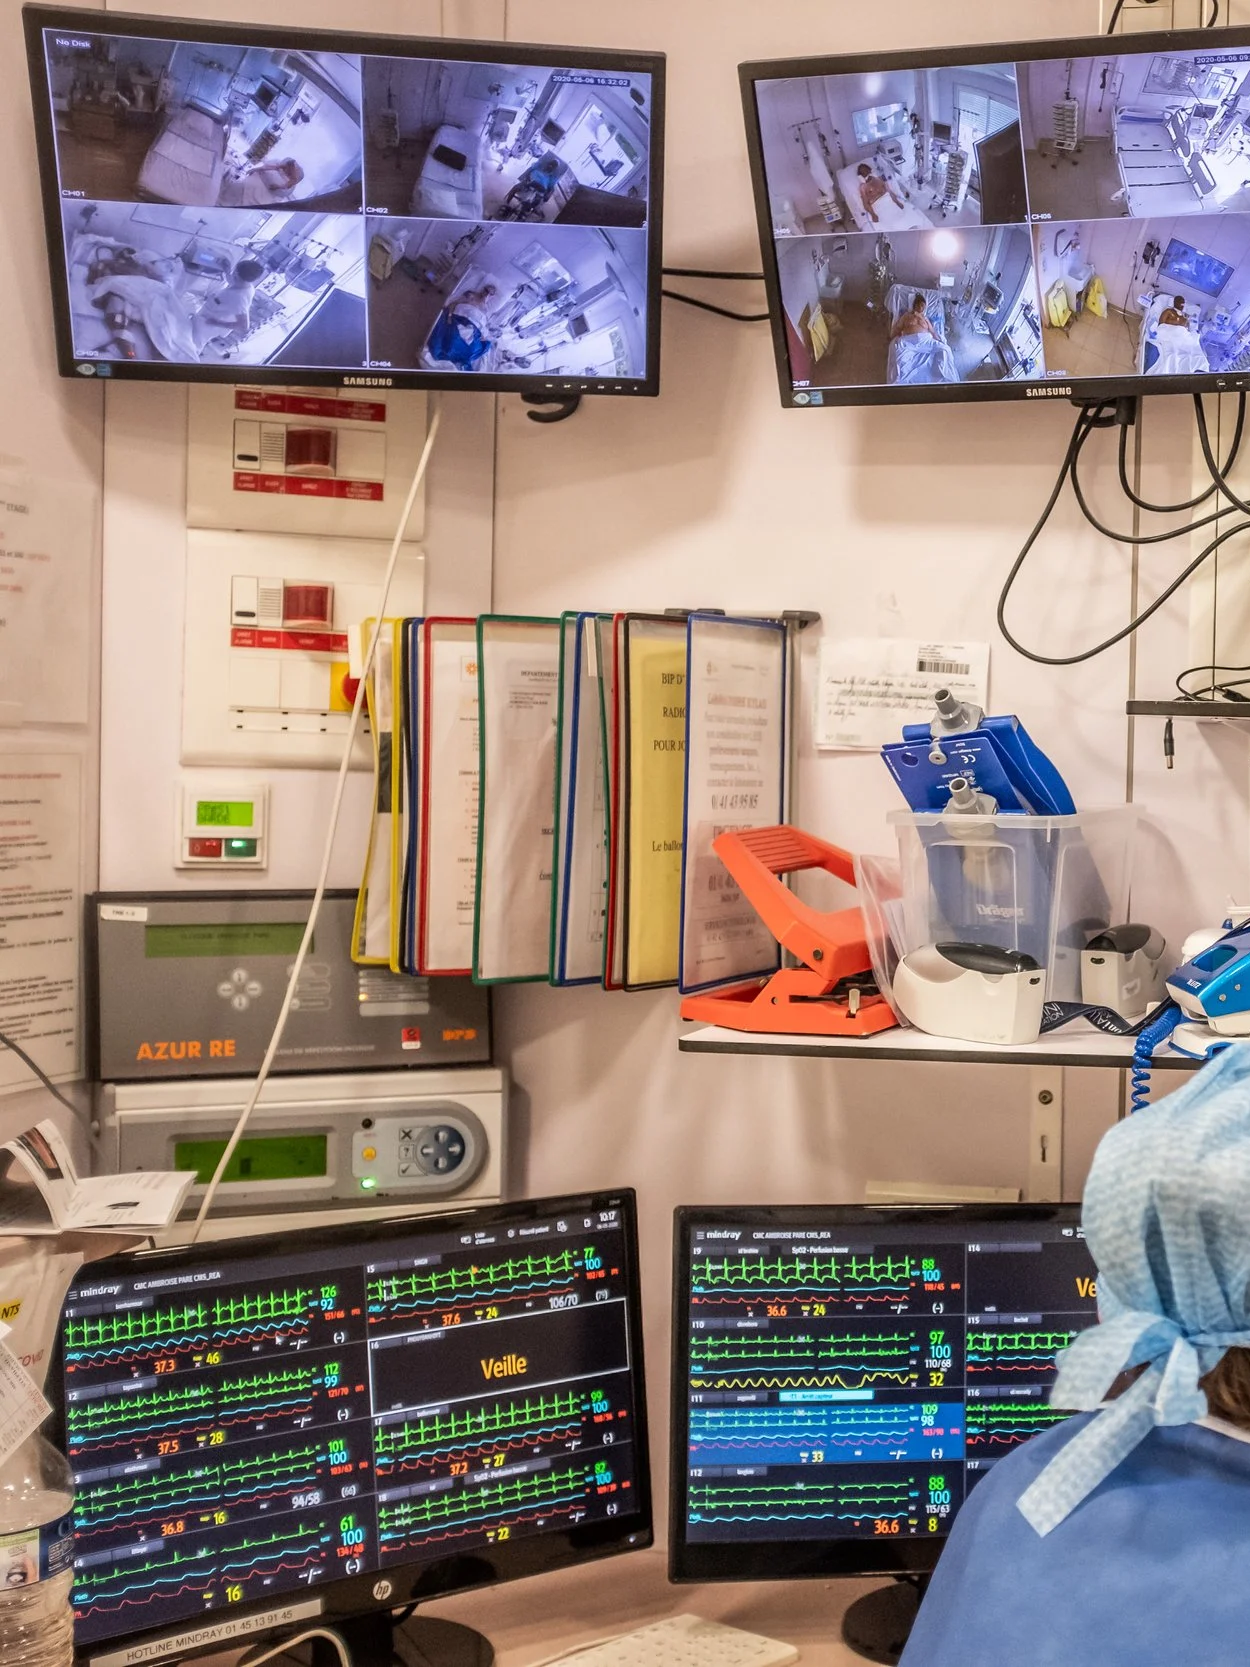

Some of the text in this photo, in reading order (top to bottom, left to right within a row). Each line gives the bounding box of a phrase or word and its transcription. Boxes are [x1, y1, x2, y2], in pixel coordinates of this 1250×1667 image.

[56, 38, 91, 48] No Disk
[62, 189, 86, 198] CH01
[366, 206, 389, 214] CH02
[343, 376, 393, 387] SAMSUNG
[1026, 387, 1072, 397] SAMSUNG
[662, 673, 675, 685] BIP
[654, 740, 676, 751] POUR
[652, 841, 661, 851] Le
[136, 1040, 236, 1061] AZUR RE
[706, 1229, 742, 1241] mindray
[793, 1231, 806, 1240] PARE
[583, 1247, 595, 1259] 77
[584, 1257, 600, 1270] 100
[921, 1259, 935, 1270] 88
[147, 1276, 178, 1288] AMBROISE
[178, 1274, 193, 1285] PARE
[922, 1269, 941, 1282] 100
[80, 1284, 120, 1298] mindray
[320, 1286, 336, 1299] 126
[320, 1299, 334, 1311] 92
[549, 1294, 579, 1309] 106/70
[486, 1307, 498, 1319] 24
[767, 1305, 788, 1317] 36.6
[813, 1304, 826, 1316] 24
[441, 1314, 461, 1326] 37.6
[929, 1331, 945, 1345] 97
[930, 1345, 951, 1359] 100
[206, 1352, 220, 1366] 46
[925, 1358, 952, 1369] 110/68
[154, 1361, 176, 1375] 37.3
[324, 1363, 339, 1375] 112
[480, 1354, 528, 1380] Veille
[324, 1375, 338, 1388] 99
[929, 1372, 945, 1387] 32
[590, 1391, 602, 1402] 99
[592, 1401, 608, 1413] 100
[921, 1404, 938, 1415] 109
[921, 1414, 935, 1427] 98
[209, 1432, 223, 1445] 28
[157, 1440, 179, 1454] 37.5
[328, 1440, 344, 1452] 101
[328, 1452, 347, 1465] 100
[493, 1454, 506, 1466] 27
[812, 1450, 824, 1463] 33
[450, 1462, 468, 1476] 37.2
[595, 1472, 612, 1485] 100
[928, 1476, 945, 1491] 88
[292, 1492, 321, 1507] 94/58
[929, 1490, 950, 1504] 100
[213, 1511, 225, 1525] 16
[340, 1516, 354, 1530] 61
[161, 1522, 185, 1536] 36.8
[874, 1519, 900, 1535] 36.6
[928, 1518, 938, 1532] 8
[341, 1530, 363, 1545] 100
[497, 1527, 510, 1540] 22
[226, 1585, 241, 1602] 16
[375, 1582, 389, 1597] hp
[127, 1609, 293, 1662] HOTLINE MINDRAY 01 45 13 91 45
